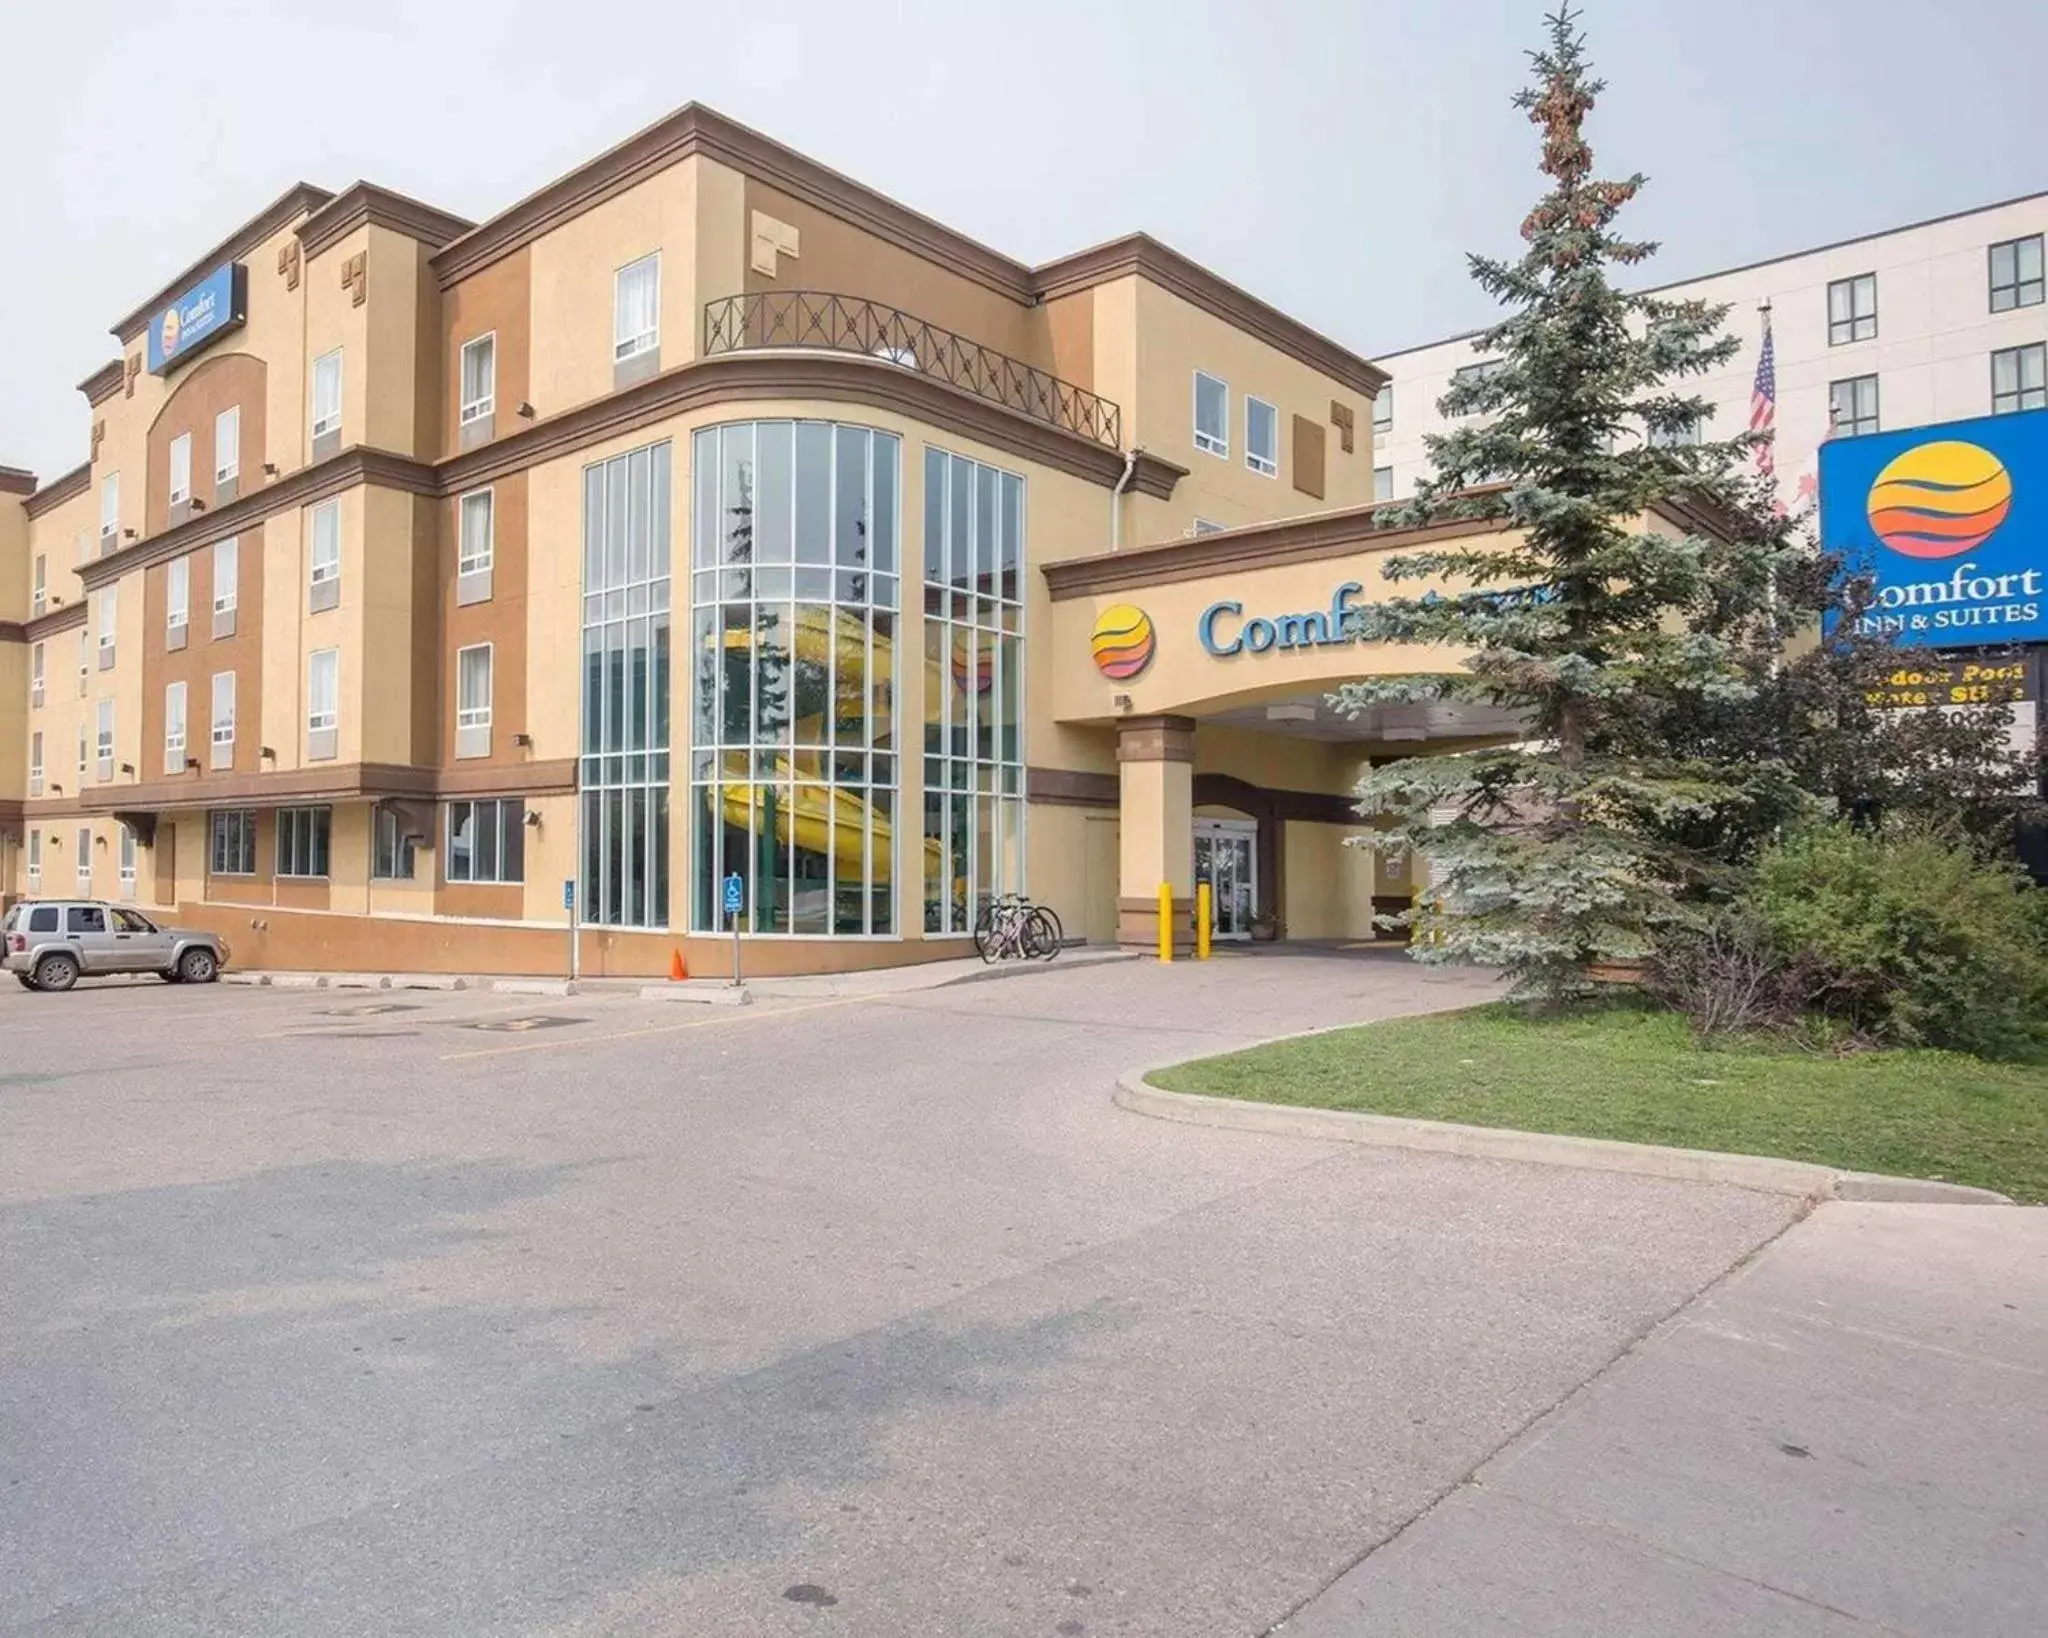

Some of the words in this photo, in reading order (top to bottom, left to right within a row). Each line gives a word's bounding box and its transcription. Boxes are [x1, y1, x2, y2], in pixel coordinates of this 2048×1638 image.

[1853, 614, 1905, 634] INN
[1911, 614, 1929, 630] &
[1934, 603, 2039, 627] SUITES
[1868, 667, 1952, 688] door
[1950, 685, 2025, 703] Slie
